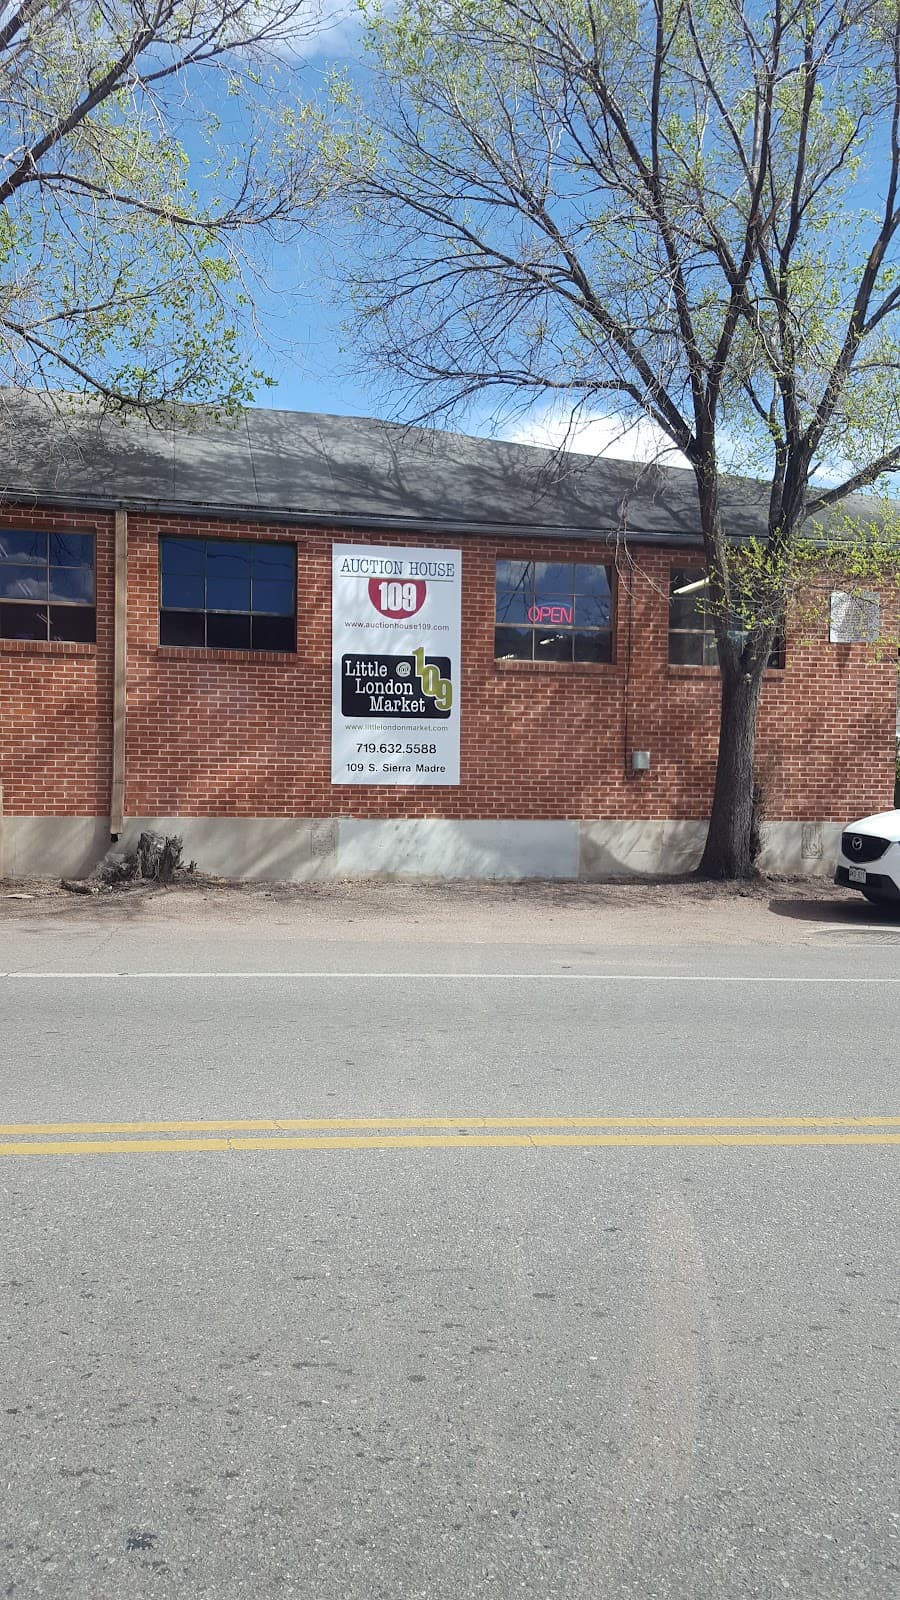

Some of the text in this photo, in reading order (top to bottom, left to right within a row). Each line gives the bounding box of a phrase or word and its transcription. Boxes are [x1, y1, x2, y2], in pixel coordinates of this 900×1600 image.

[340, 558, 455, 577] AUCTION HOUSE
[378, 581, 417, 612] 109
[527, 605, 573, 623] OPEN
[344, 620, 450, 632] www.auctionhouse109.com
[345, 660, 388, 677] Little
[355, 678, 414, 695] London
[369, 696, 426, 713] Market
[345, 723, 448, 732] www.littlelondonmarket.com
[356, 743, 437, 754] 719.632.5588
[346, 763, 446, 773] 109 S. Sierra Madre
